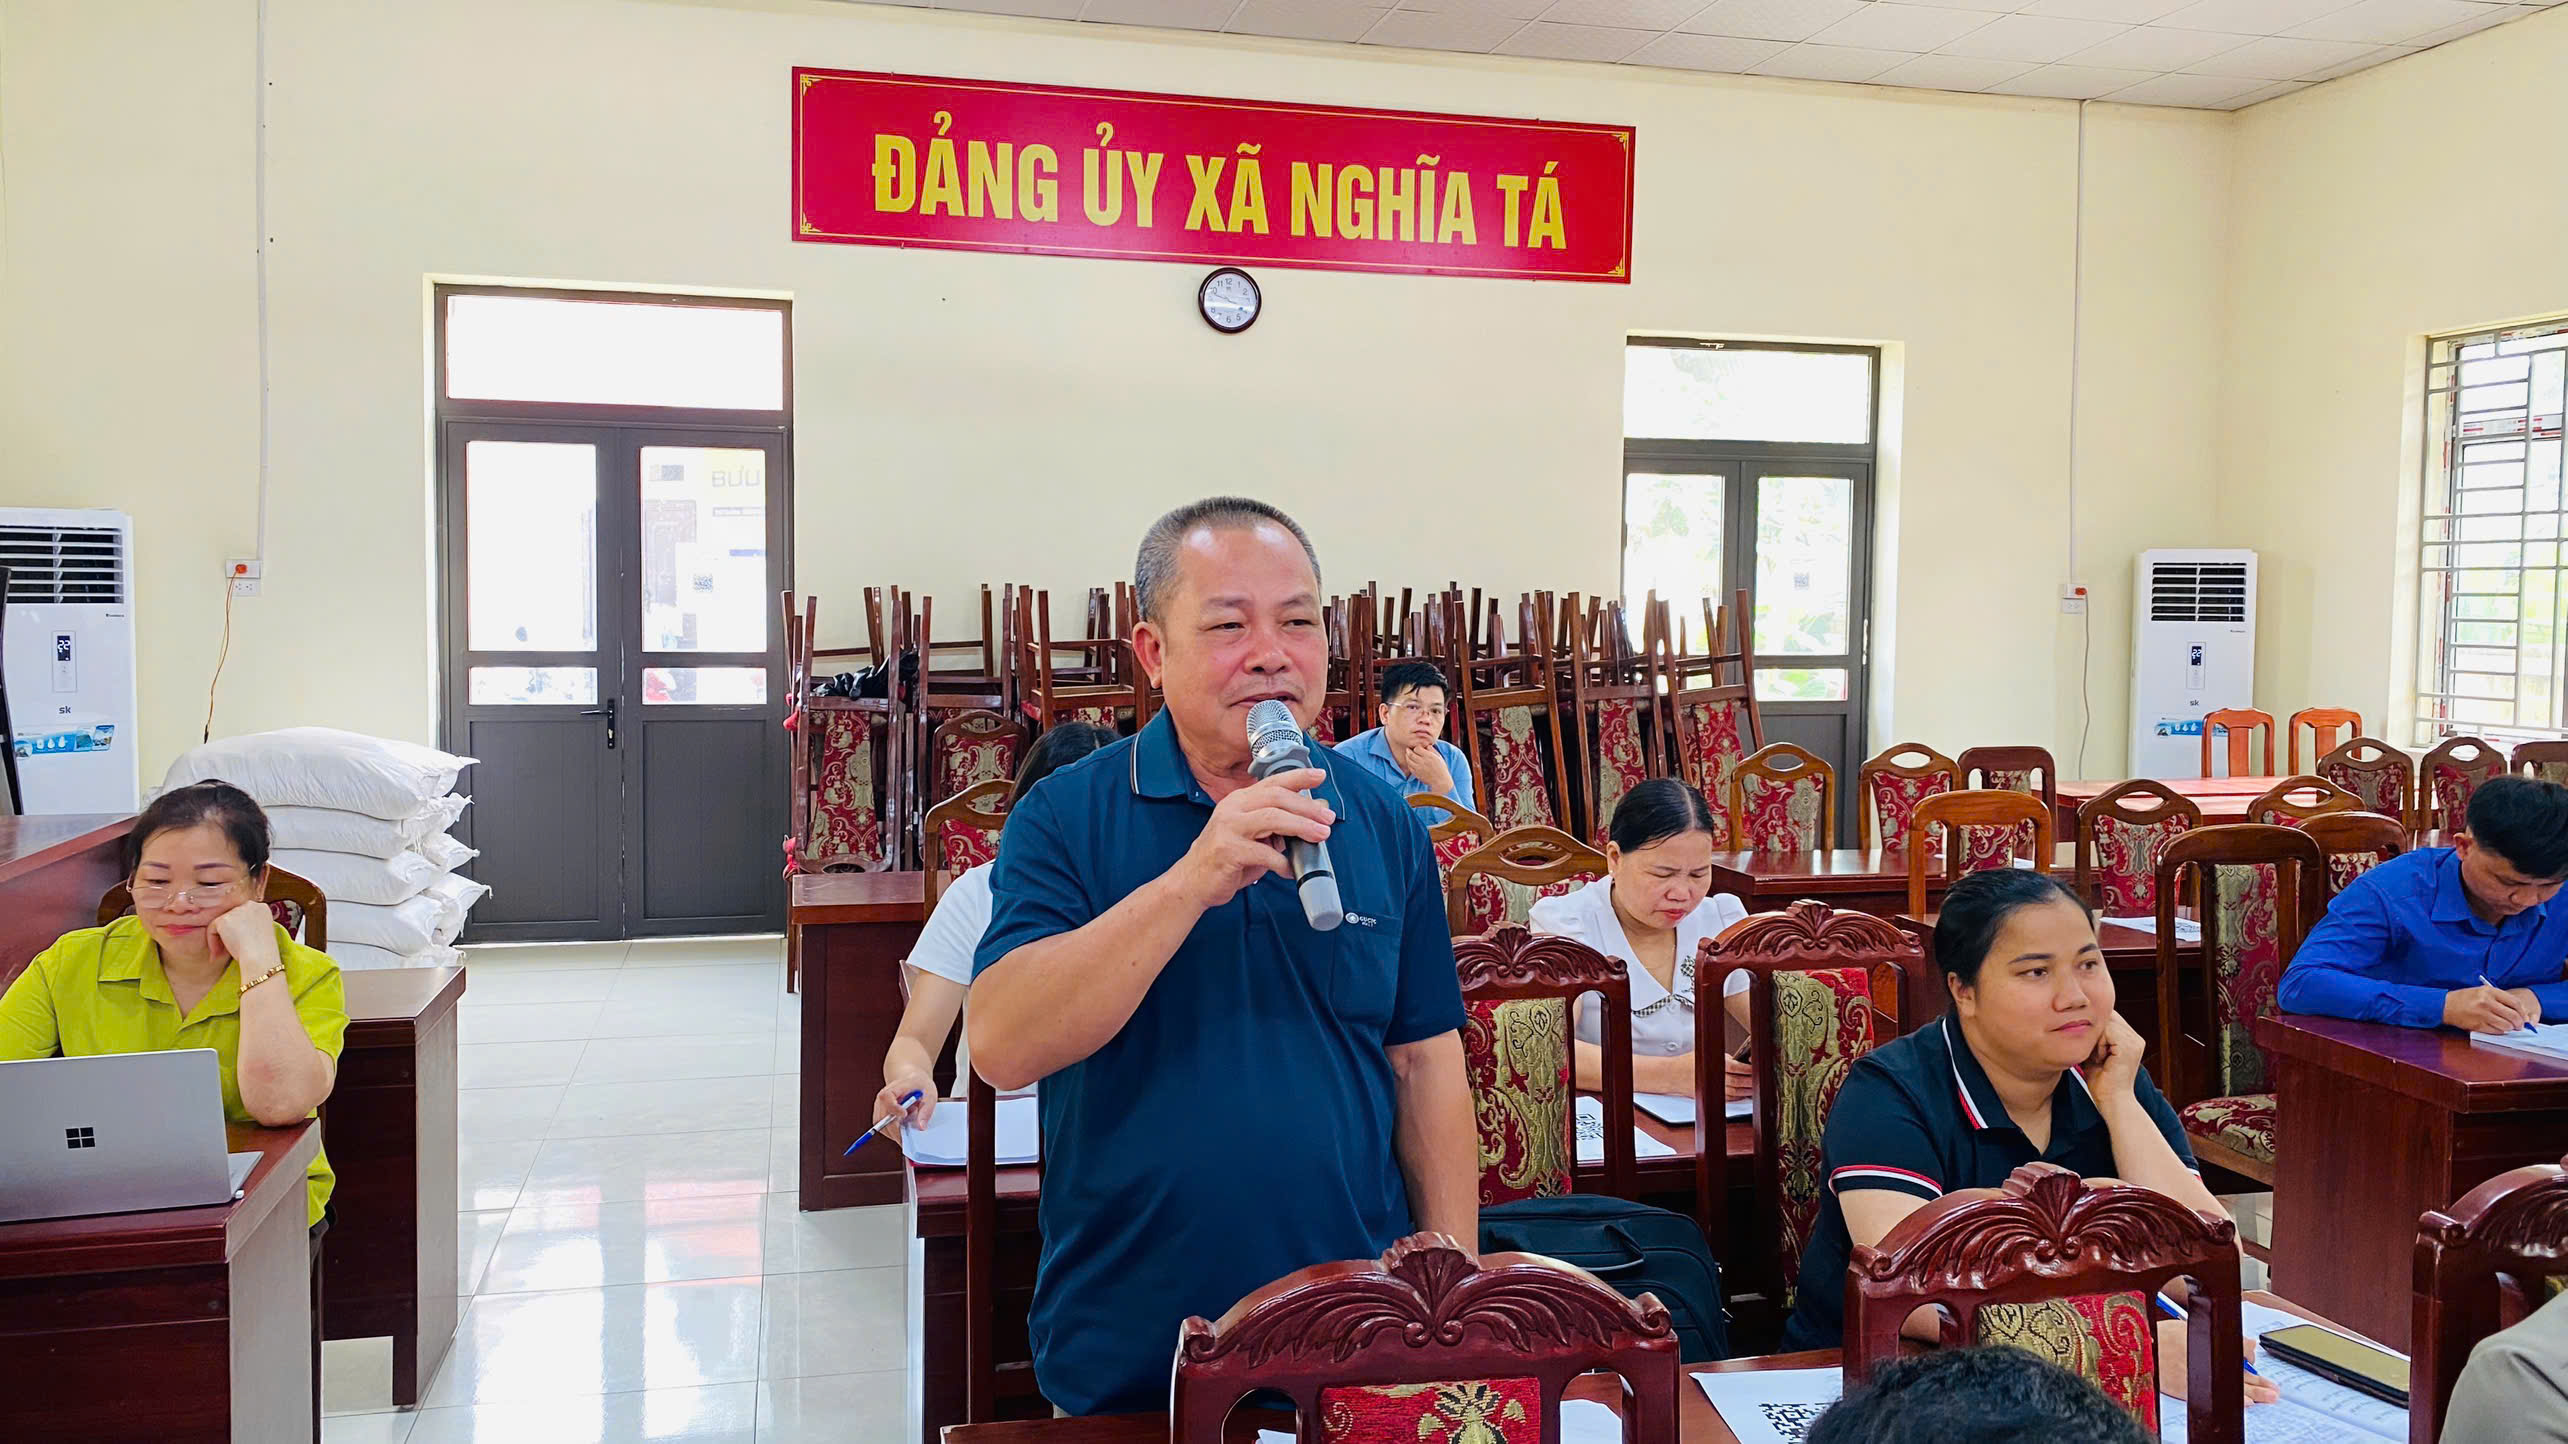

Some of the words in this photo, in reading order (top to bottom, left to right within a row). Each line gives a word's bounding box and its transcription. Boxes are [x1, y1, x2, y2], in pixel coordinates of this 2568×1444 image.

[872, 111, 1057, 222] ĐẢNG
[1084, 122, 1163, 228] ỦY
[1185, 142, 1272, 235] XÃ
[1291, 154, 1477, 246] NGHĨA
[1497, 161, 1567, 249] TÁ
